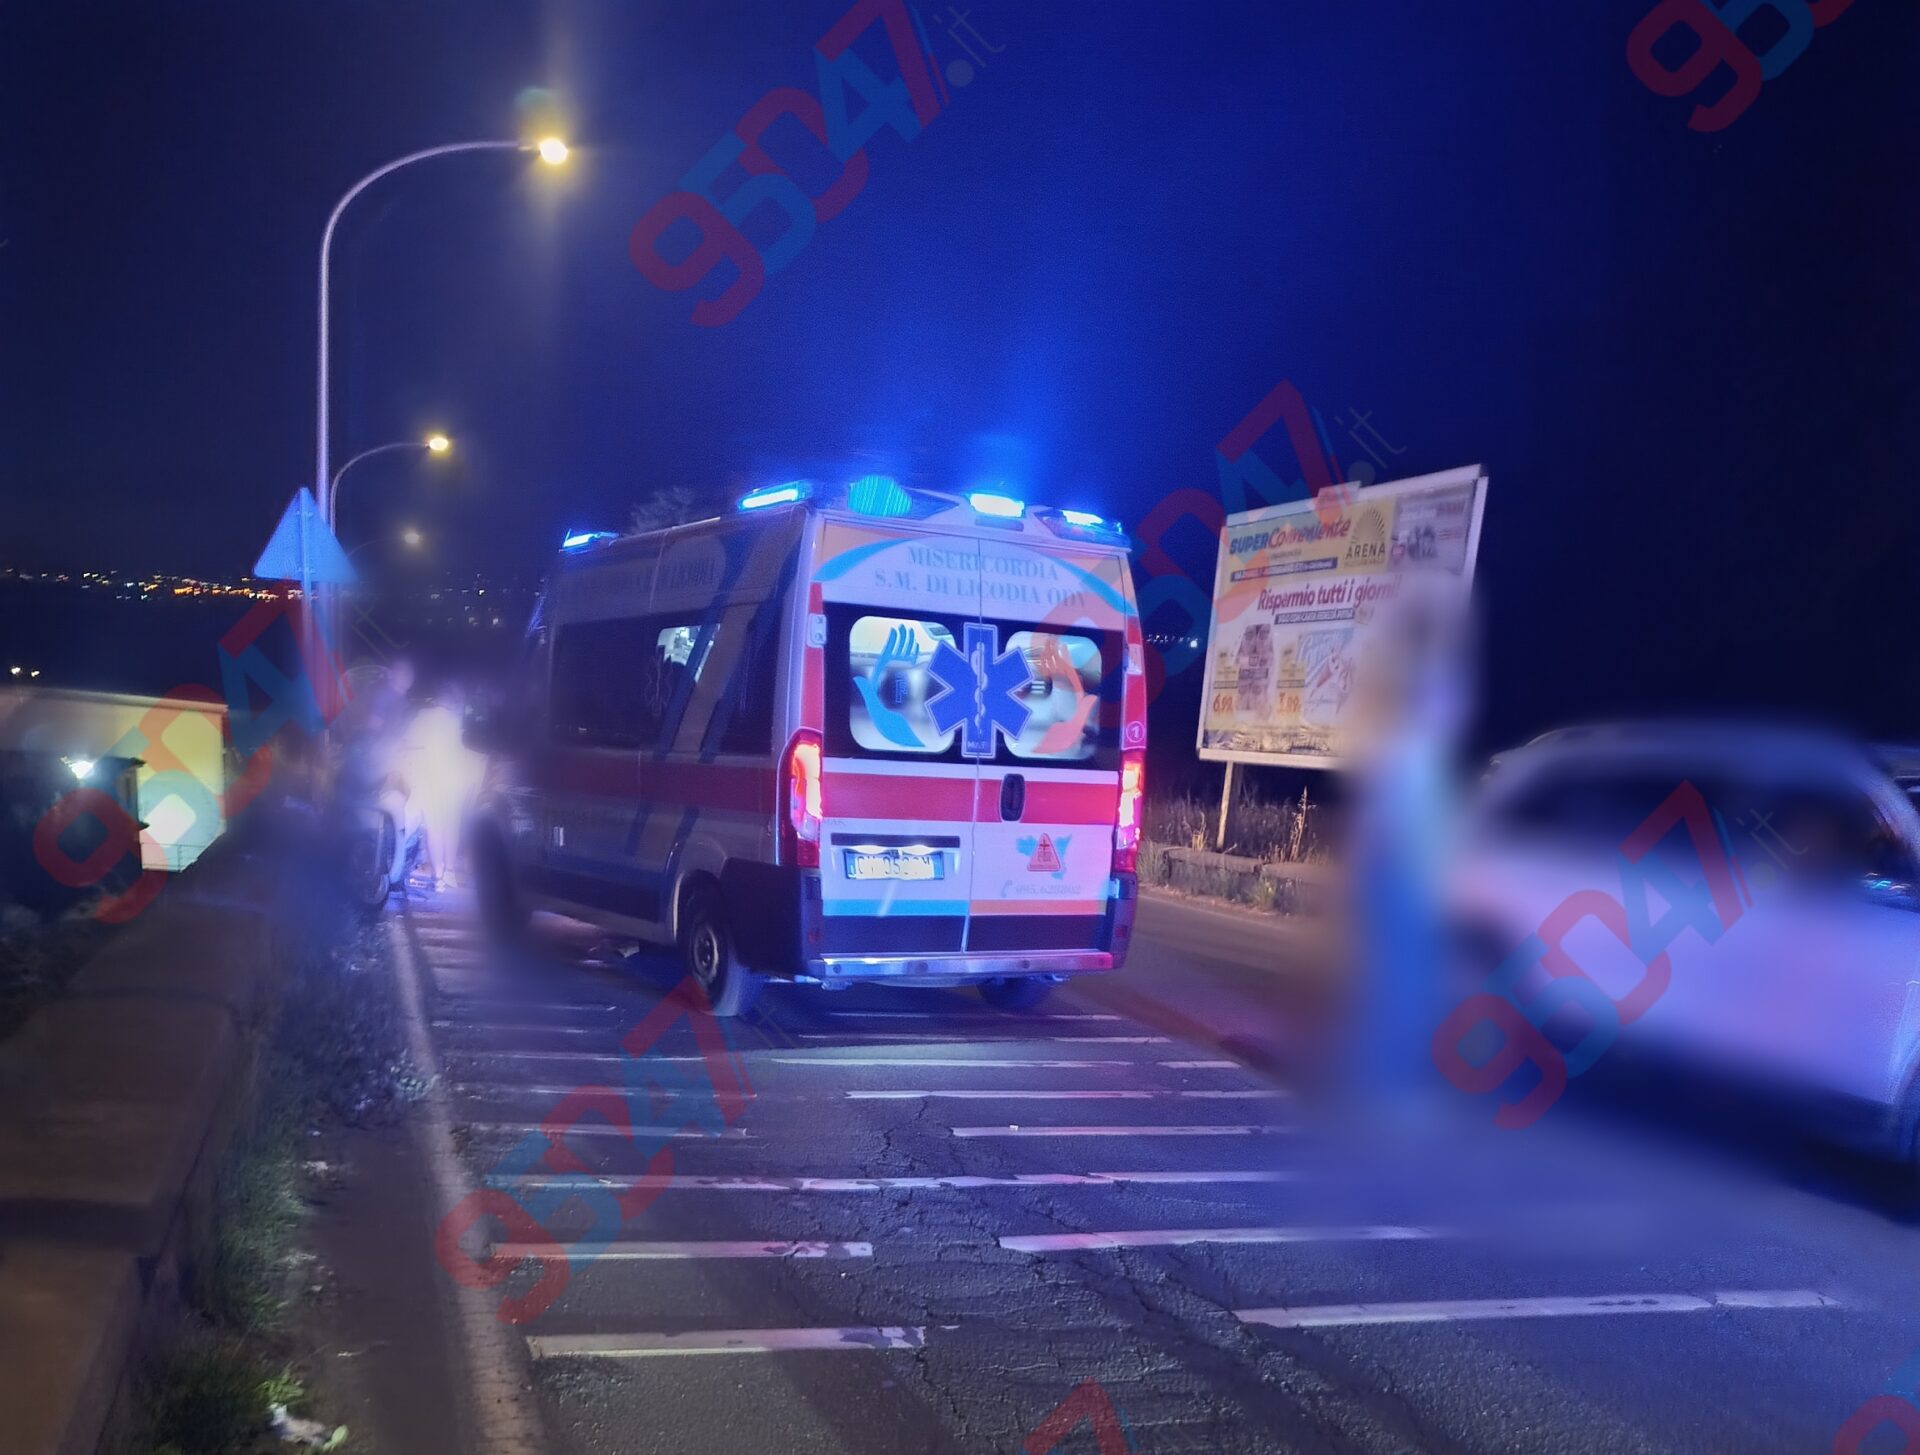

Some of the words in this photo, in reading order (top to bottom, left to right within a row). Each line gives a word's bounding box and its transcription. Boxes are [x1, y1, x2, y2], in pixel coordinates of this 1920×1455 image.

[907, 545, 1058, 580] MISERICORDIA
[1345, 541, 1386, 560] ARENA
[874, 568, 918, 592] S.M.
[926, 574, 950, 593] DI
[954, 578, 1041, 604] LICODIA
[1257, 583, 1315, 615] Risparmio
[1316, 578, 1348, 604] tutti
